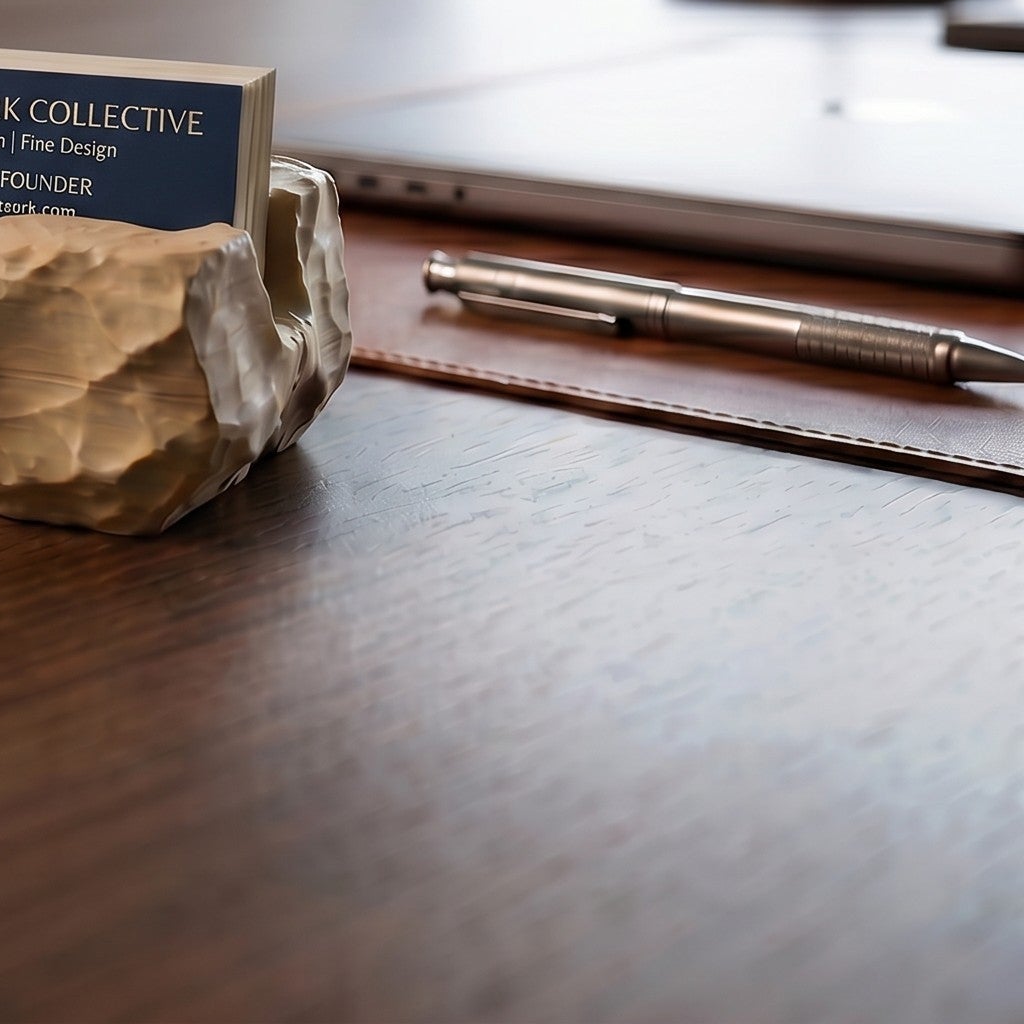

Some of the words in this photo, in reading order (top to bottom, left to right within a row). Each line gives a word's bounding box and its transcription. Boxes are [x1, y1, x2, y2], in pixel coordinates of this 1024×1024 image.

[29, 98, 204, 136] COLLECTIVE
[20, 133, 55, 154] Fine
[60, 137, 117, 162] Design
[0, 170, 93, 197] FOUNDER
